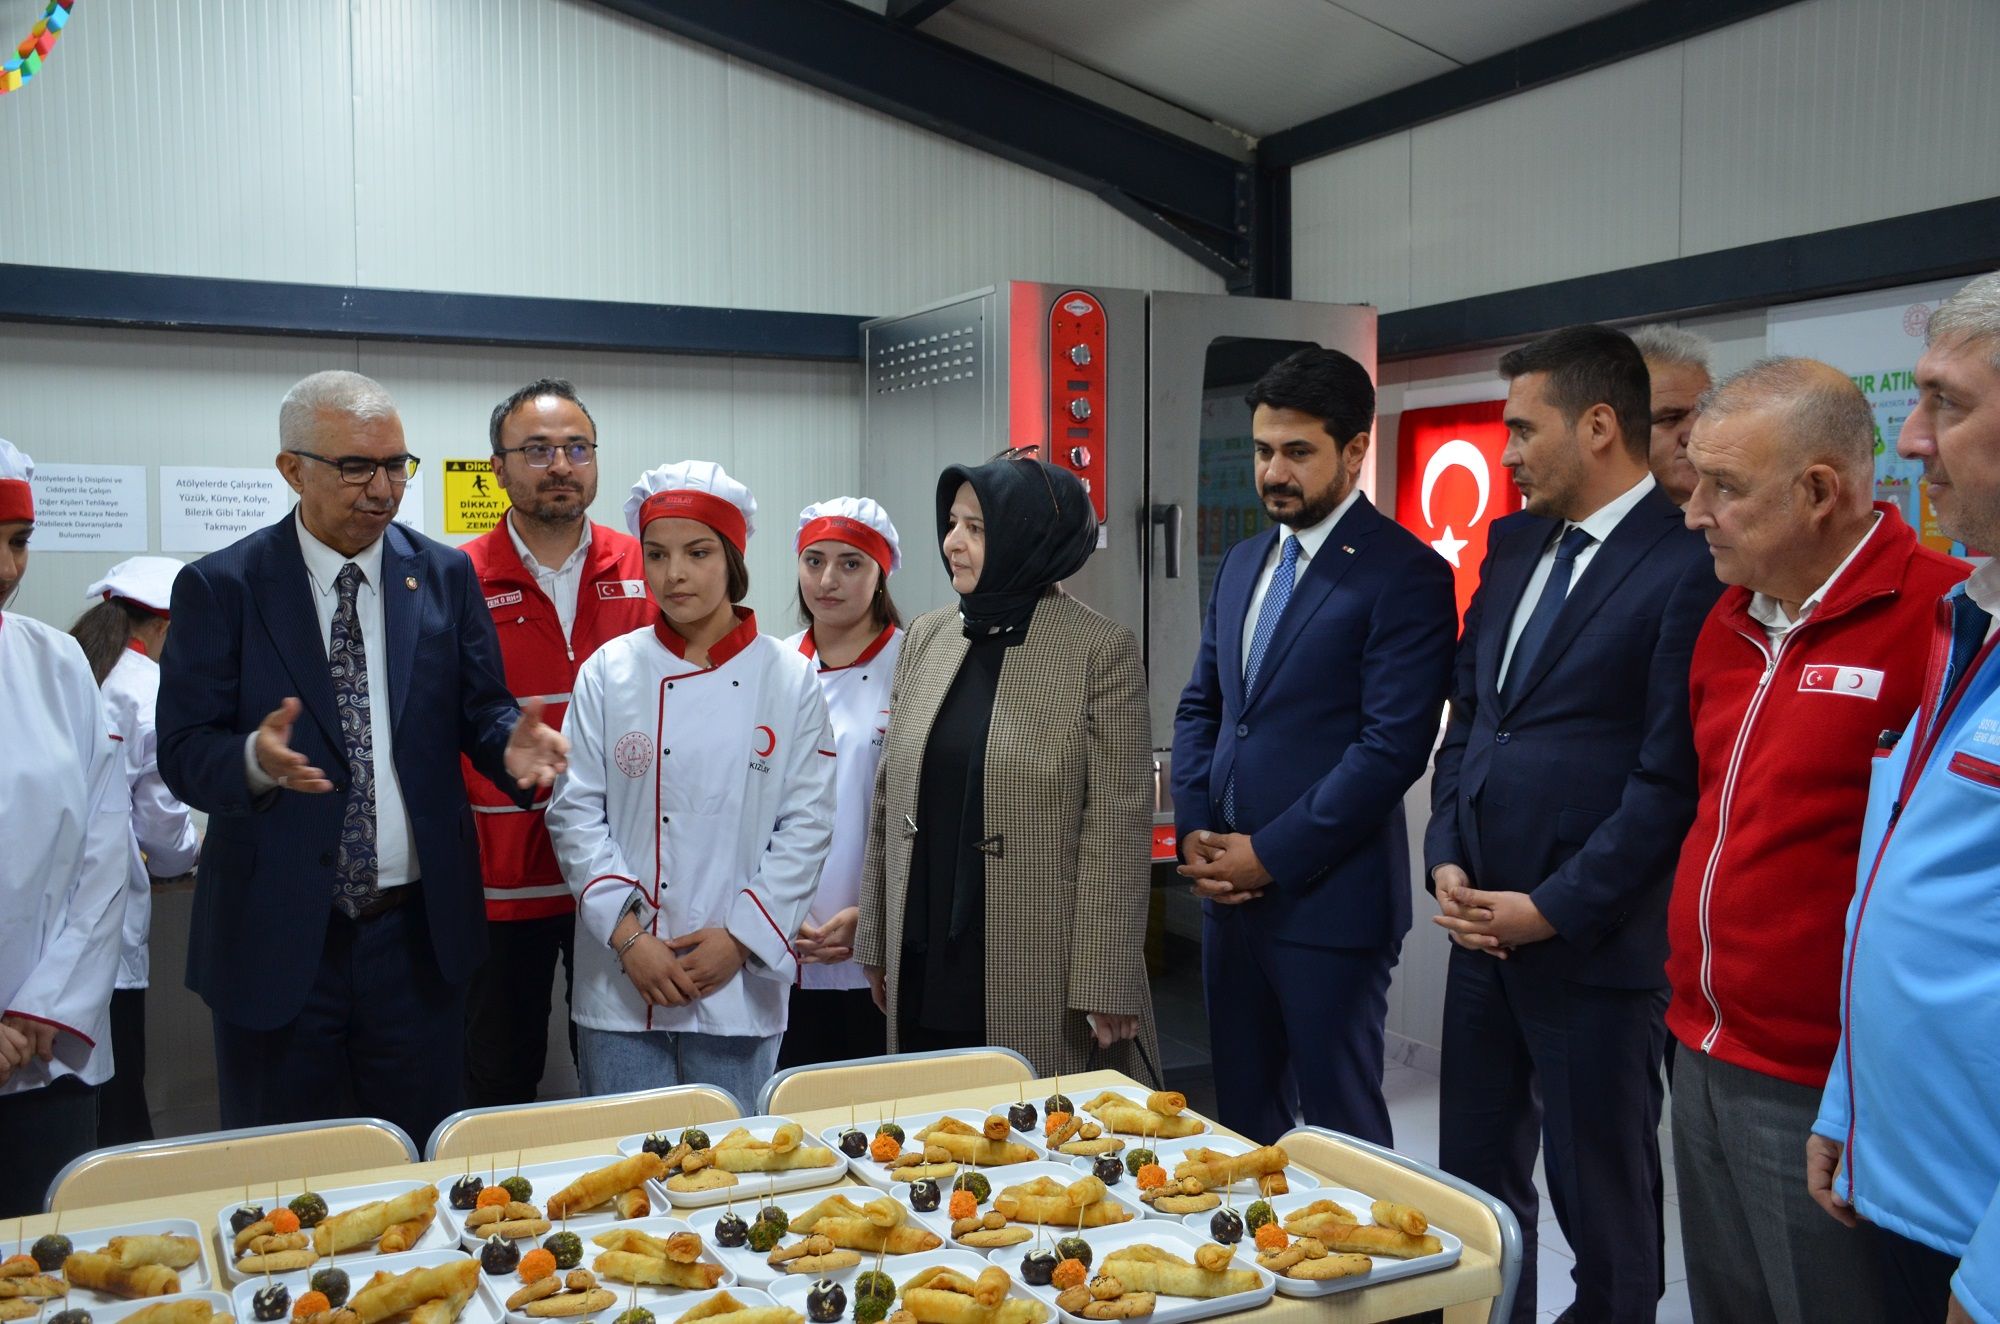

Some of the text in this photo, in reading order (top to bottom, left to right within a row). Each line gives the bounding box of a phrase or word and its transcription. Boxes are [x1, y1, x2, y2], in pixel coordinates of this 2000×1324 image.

[34, 475, 75, 483] Atölyelerde
[84, 476, 112, 484] Disiplini
[176, 479, 273, 490] Atölyelerde Çalışırken
[46, 486, 77, 494] Ciddiyeti
[89, 487, 112, 495] Çalışın
[39, 498, 119, 507] Diğer Kişileri Tehlikeye
[180, 494, 270, 504] Yüzük, Künye, Kolye,
[460, 500, 498, 509] DİKKAT
[185, 508, 265, 518] Bilezik Gibi Takılar
[461, 511, 504, 519] KAYGAN
[36, 520, 123, 529] Olabilecek Davranışlarda
[204, 522, 247, 532] Takmayın
[58, 531, 101, 539] Bulunmayın
